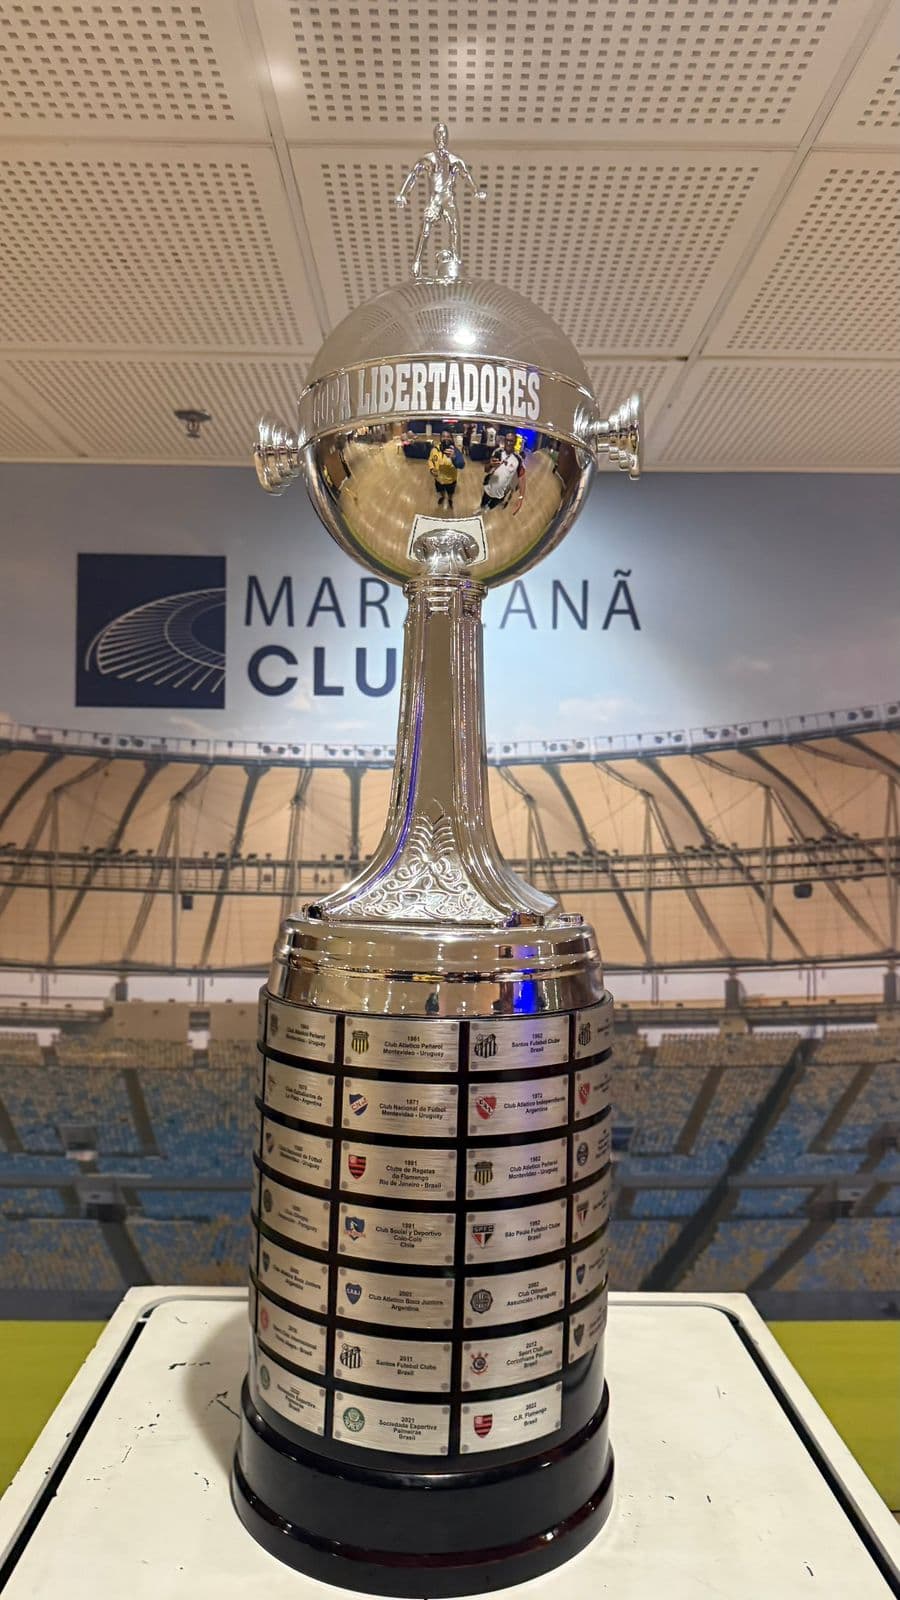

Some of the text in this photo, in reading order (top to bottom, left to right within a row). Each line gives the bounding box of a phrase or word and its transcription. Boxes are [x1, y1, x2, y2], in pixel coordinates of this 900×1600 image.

[357, 361, 540, 420] LIBERTADORES
[244, 569, 641, 631] MARANÃ
[247, 644, 398, 698] CLU
[420, 1050, 444, 1058] Uruguay
[382, 1110, 414, 1118] Montevideo
[525, 1106, 548, 1114] Argentina
[508, 1171, 537, 1180] Montevideo
[540, 1167, 558, 1176] Uruguay
[413, 1229, 442, 1238] Deportivo
[516, 1229, 530, 1237] Paulo
[518, 1290, 530, 1298] Club
[391, 1304, 419, 1312] Argentina
[523, 1360, 537, 1368] Brasil
[524, 1407, 547, 1418] Flamengo
[379, 1419, 437, 1431] Sociedade Esportiva
[523, 1418, 537, 1427] Brasil
[392, 1427, 421, 1435] Palmeiras
